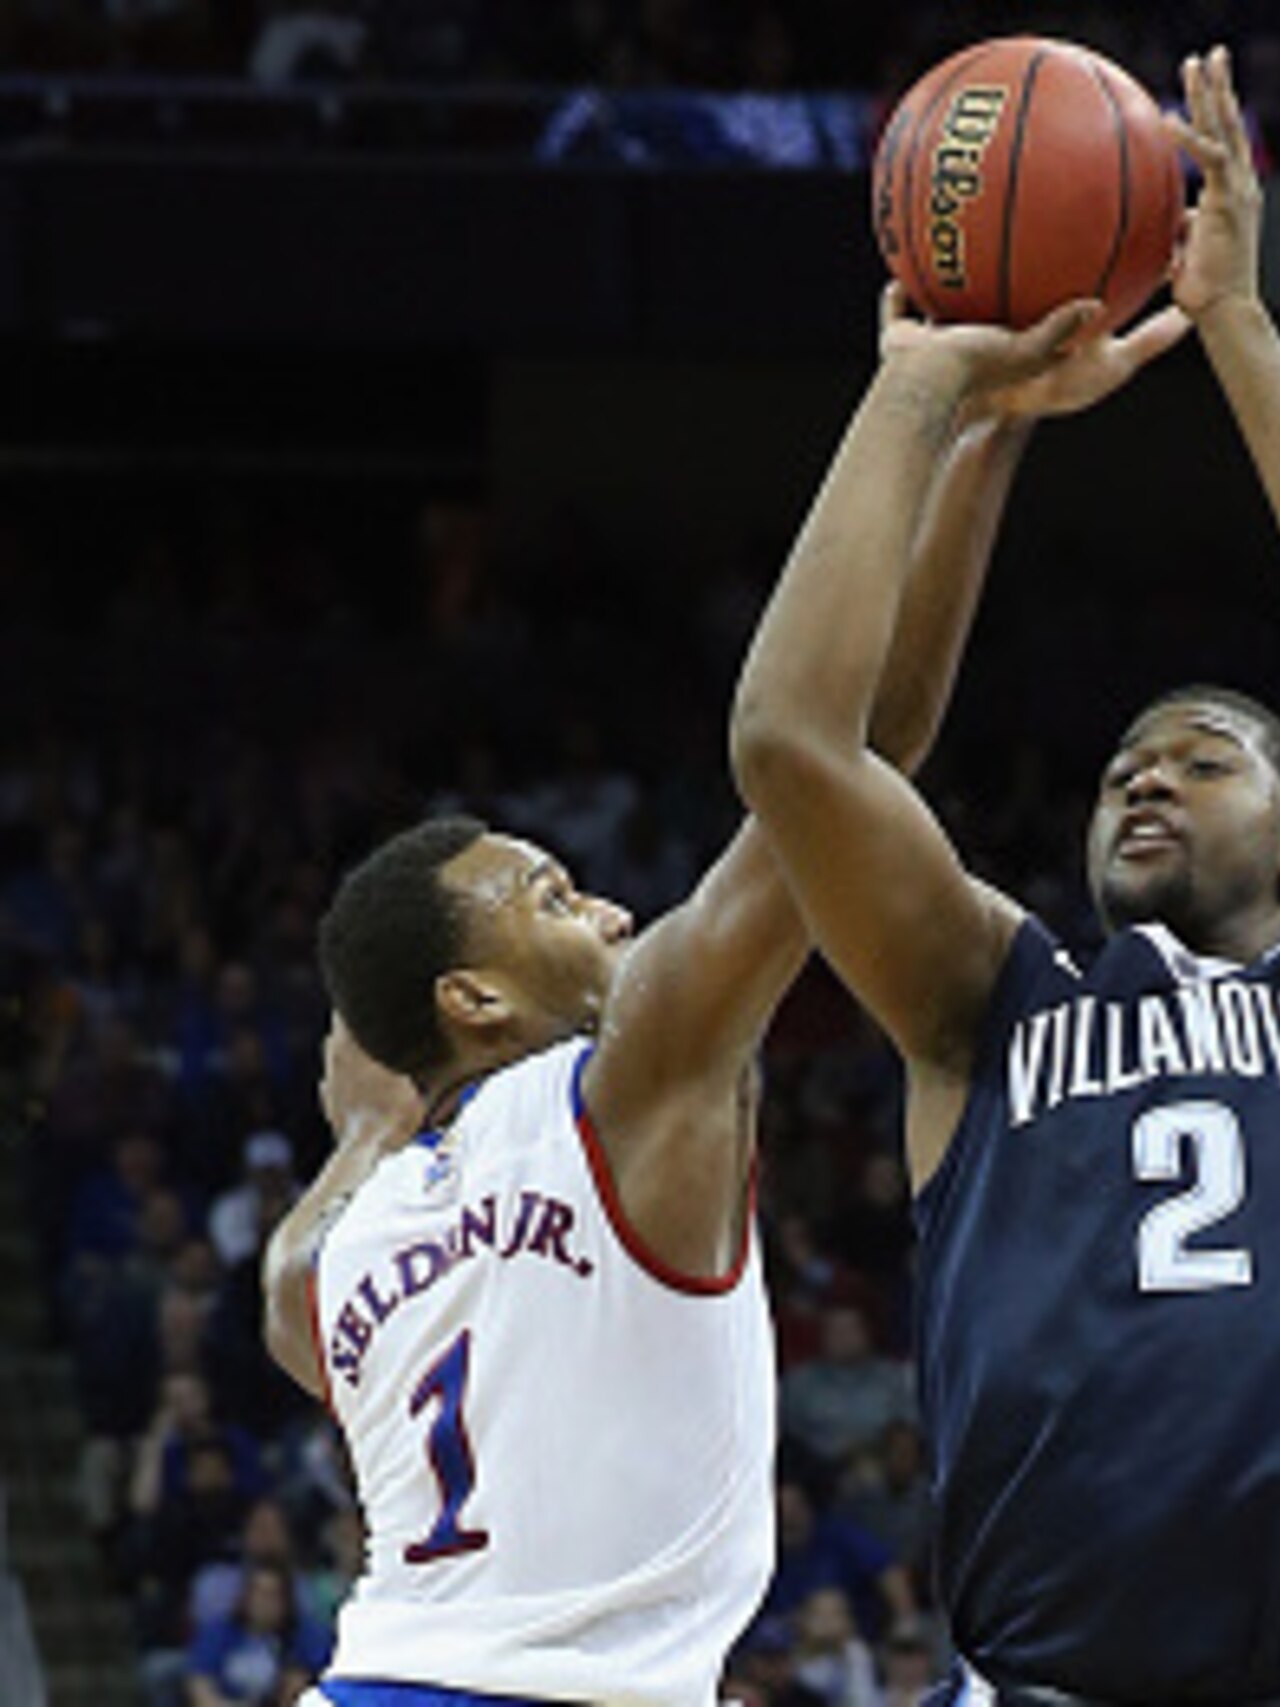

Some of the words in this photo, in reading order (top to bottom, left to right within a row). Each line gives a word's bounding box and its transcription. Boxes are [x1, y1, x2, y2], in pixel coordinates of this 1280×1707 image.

[931, 85, 1007, 289] Wilson
[331, 1195, 496, 1387] SELDN
[499, 1192, 594, 1278] JR.
[1132, 1100, 1252, 1291] 2
[404, 1328, 489, 1564] 1
